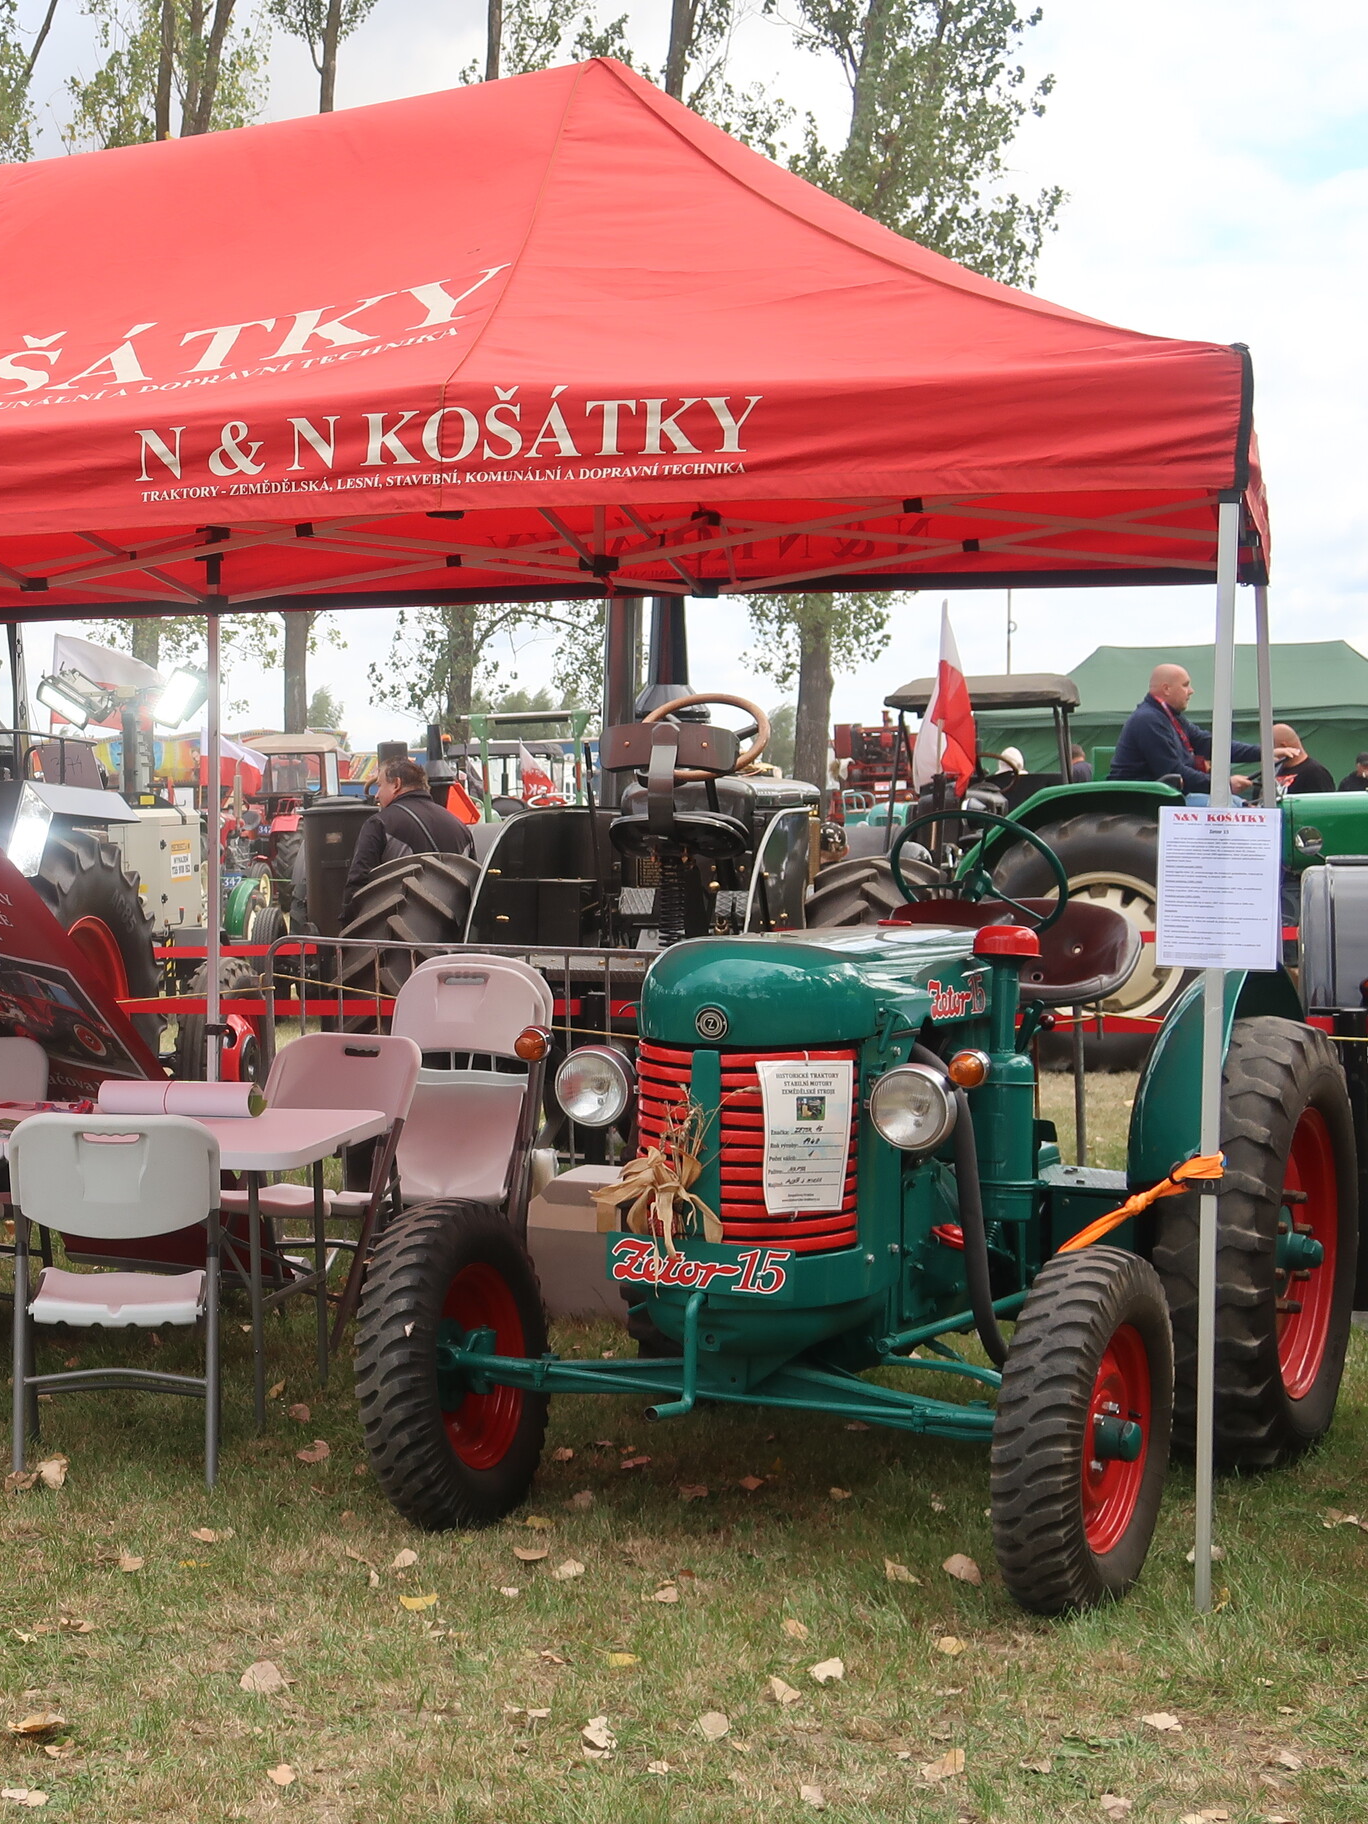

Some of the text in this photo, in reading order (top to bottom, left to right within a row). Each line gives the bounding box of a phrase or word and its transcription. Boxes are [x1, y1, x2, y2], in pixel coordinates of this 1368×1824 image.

[137, 360, 295, 395] DOPRAVNÍ
[299, 327, 459, 371] TECHNIKA
[134, 385, 764, 482] N & N KOŠÁTKY
[141, 485, 221, 502] TRAKTORY
[229, 477, 333, 496] ZEMĚDĚLSKÁ,
[337, 473, 383, 490] LESNÍ,
[385, 468, 461, 487] STAVEBNÍ,
[464, 466, 562, 483] KOMUNÁLNÍ
[565, 468, 576, 481] A
[579, 462, 660, 480] DOPRAVNÍ
[662, 461, 746, 476] TECHNIKA
[1174, 812, 1267, 823] N&N KOŠÁTKY
[968, 974, 986, 1014] 15
[612, 1237, 791, 1295] Zetor 15
